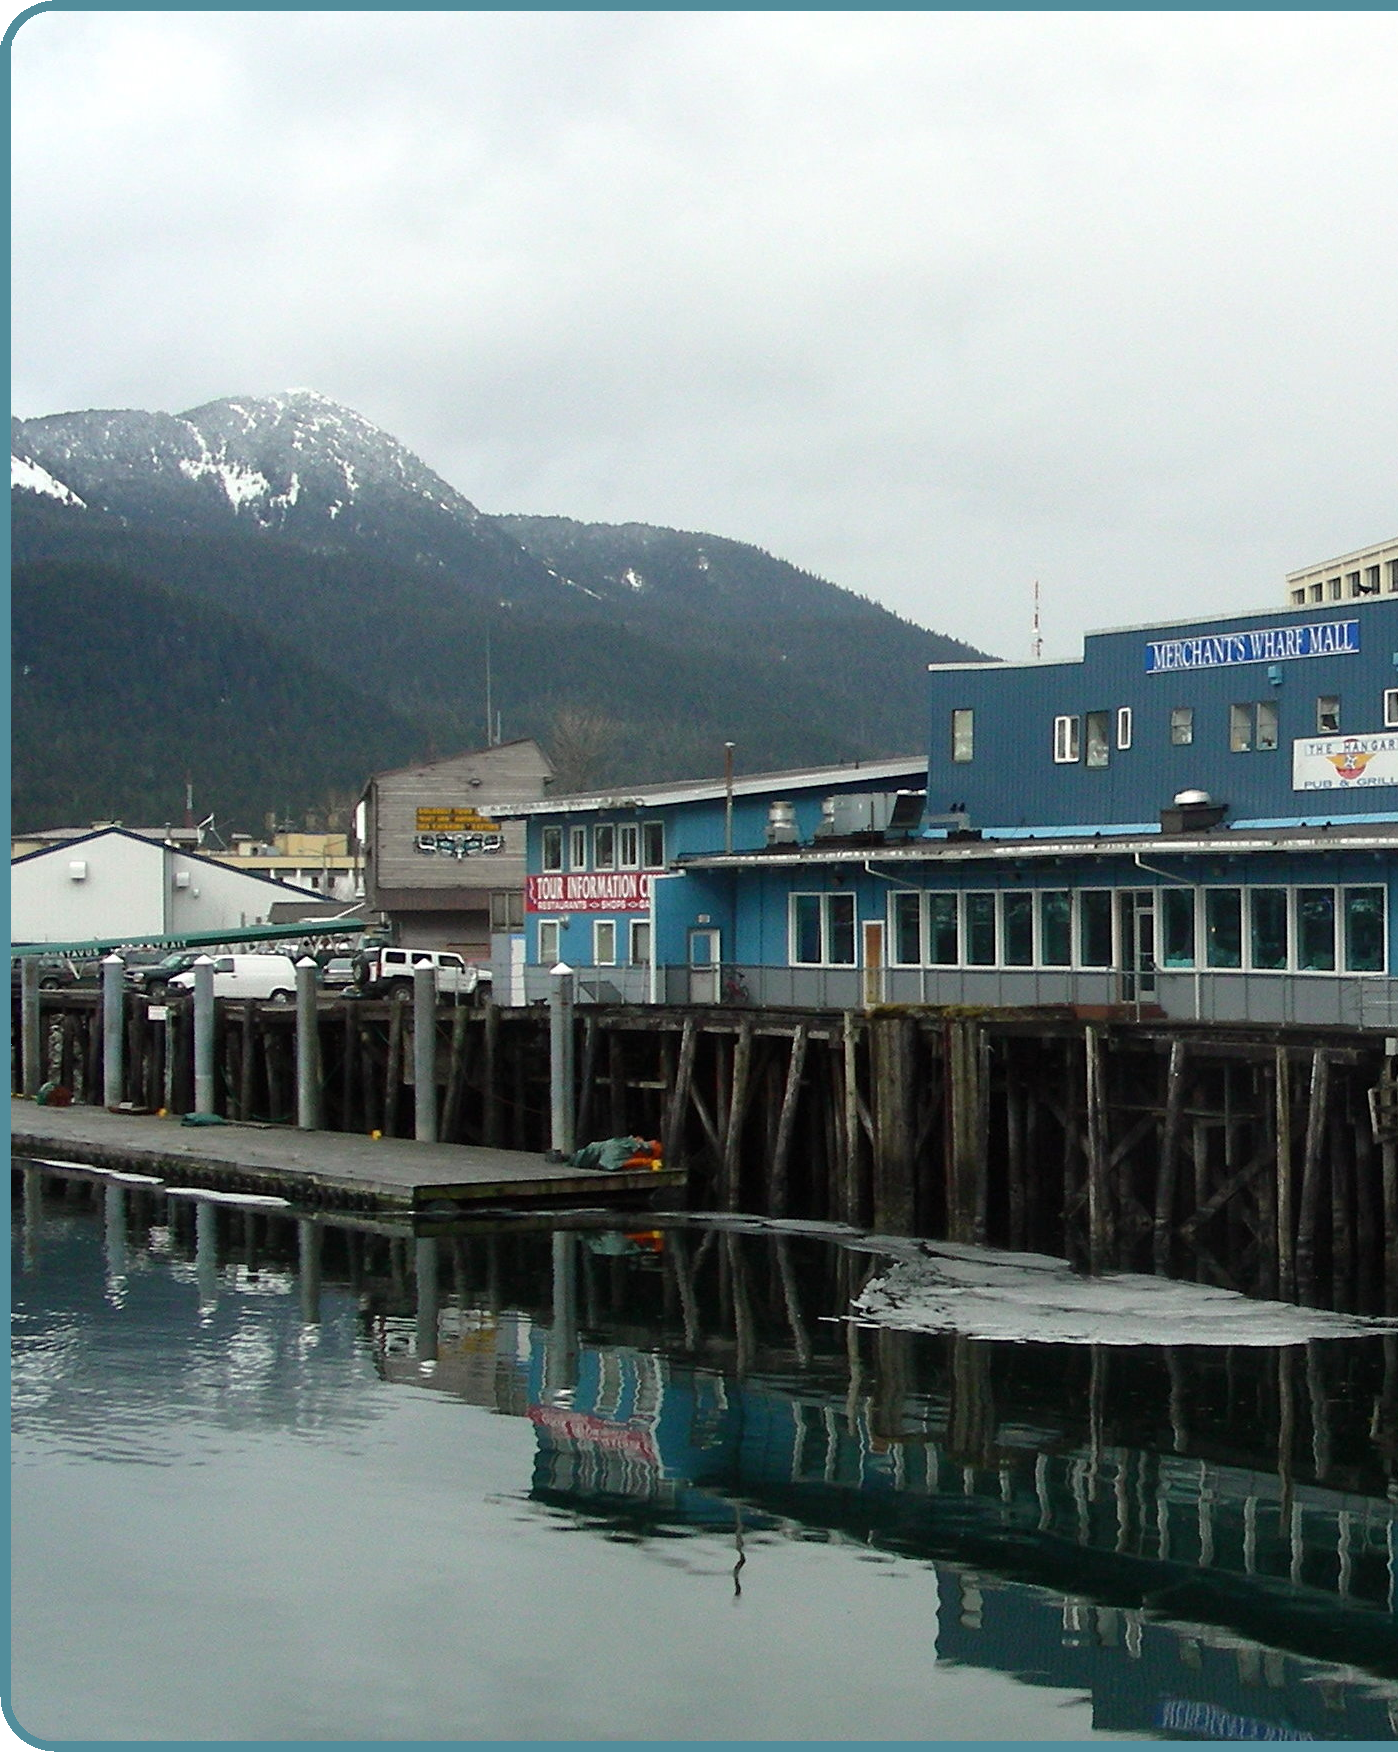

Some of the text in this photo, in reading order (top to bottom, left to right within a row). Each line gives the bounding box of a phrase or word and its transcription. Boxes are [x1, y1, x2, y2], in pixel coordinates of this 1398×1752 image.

[1153, 623, 1354, 670] MERCHANT'S WHARF MALL
[1309, 739, 1396, 755] THE HANGAR
[1304, 780, 1333, 789] PUB
[1340, 780, 1350, 788] &
[537, 876, 564, 899] TOUR
[567, 874, 637, 899] INFORMATION
[537, 901, 588, 910] RESTAURANTS
[600, 900, 627, 909] SHOPS
